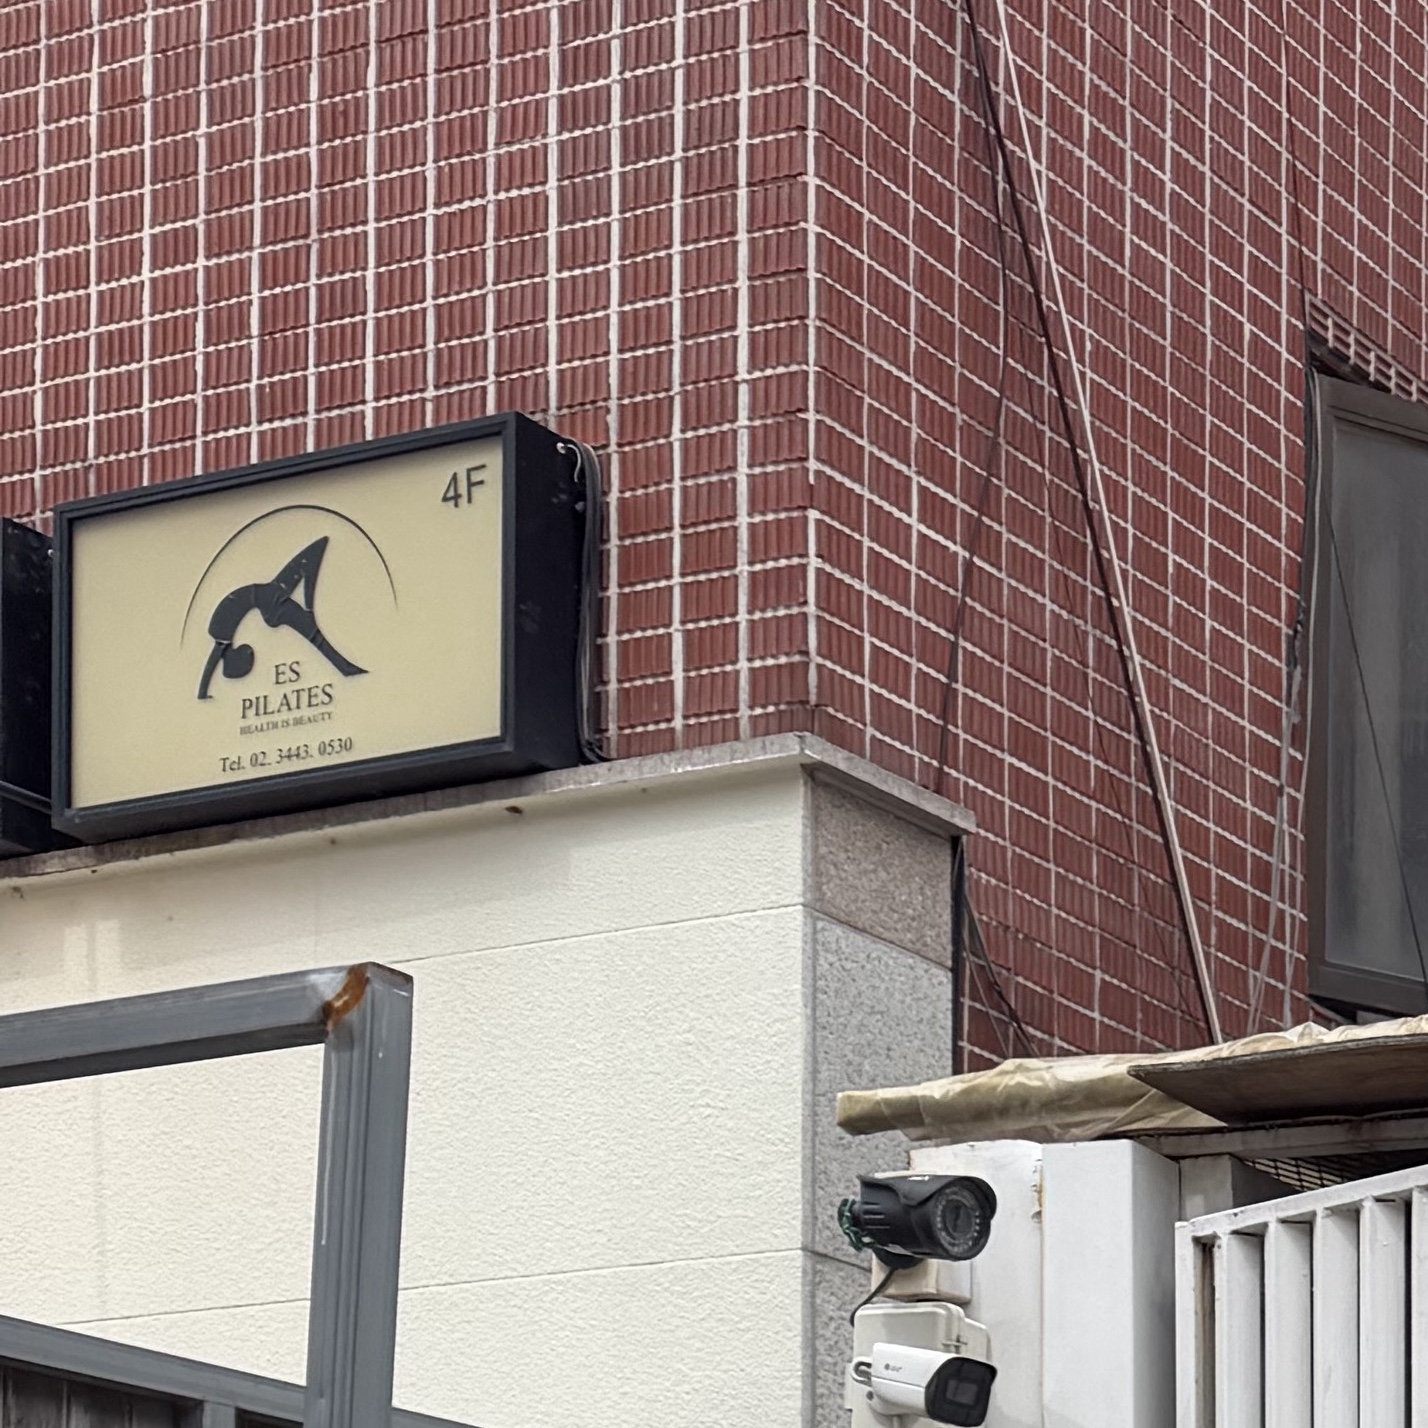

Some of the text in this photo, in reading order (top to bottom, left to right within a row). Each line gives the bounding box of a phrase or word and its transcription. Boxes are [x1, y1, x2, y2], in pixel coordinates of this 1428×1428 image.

[441, 463, 487, 508] 4F
[274, 661, 300, 685] ES
[241, 683, 334, 719] PILATES
[239, 711, 333, 735] HEALTH IS BEAUTY
[219, 756, 245, 772] Tel.
[250, 751, 271, 767] 02.
[318, 737, 353, 756] 0530
